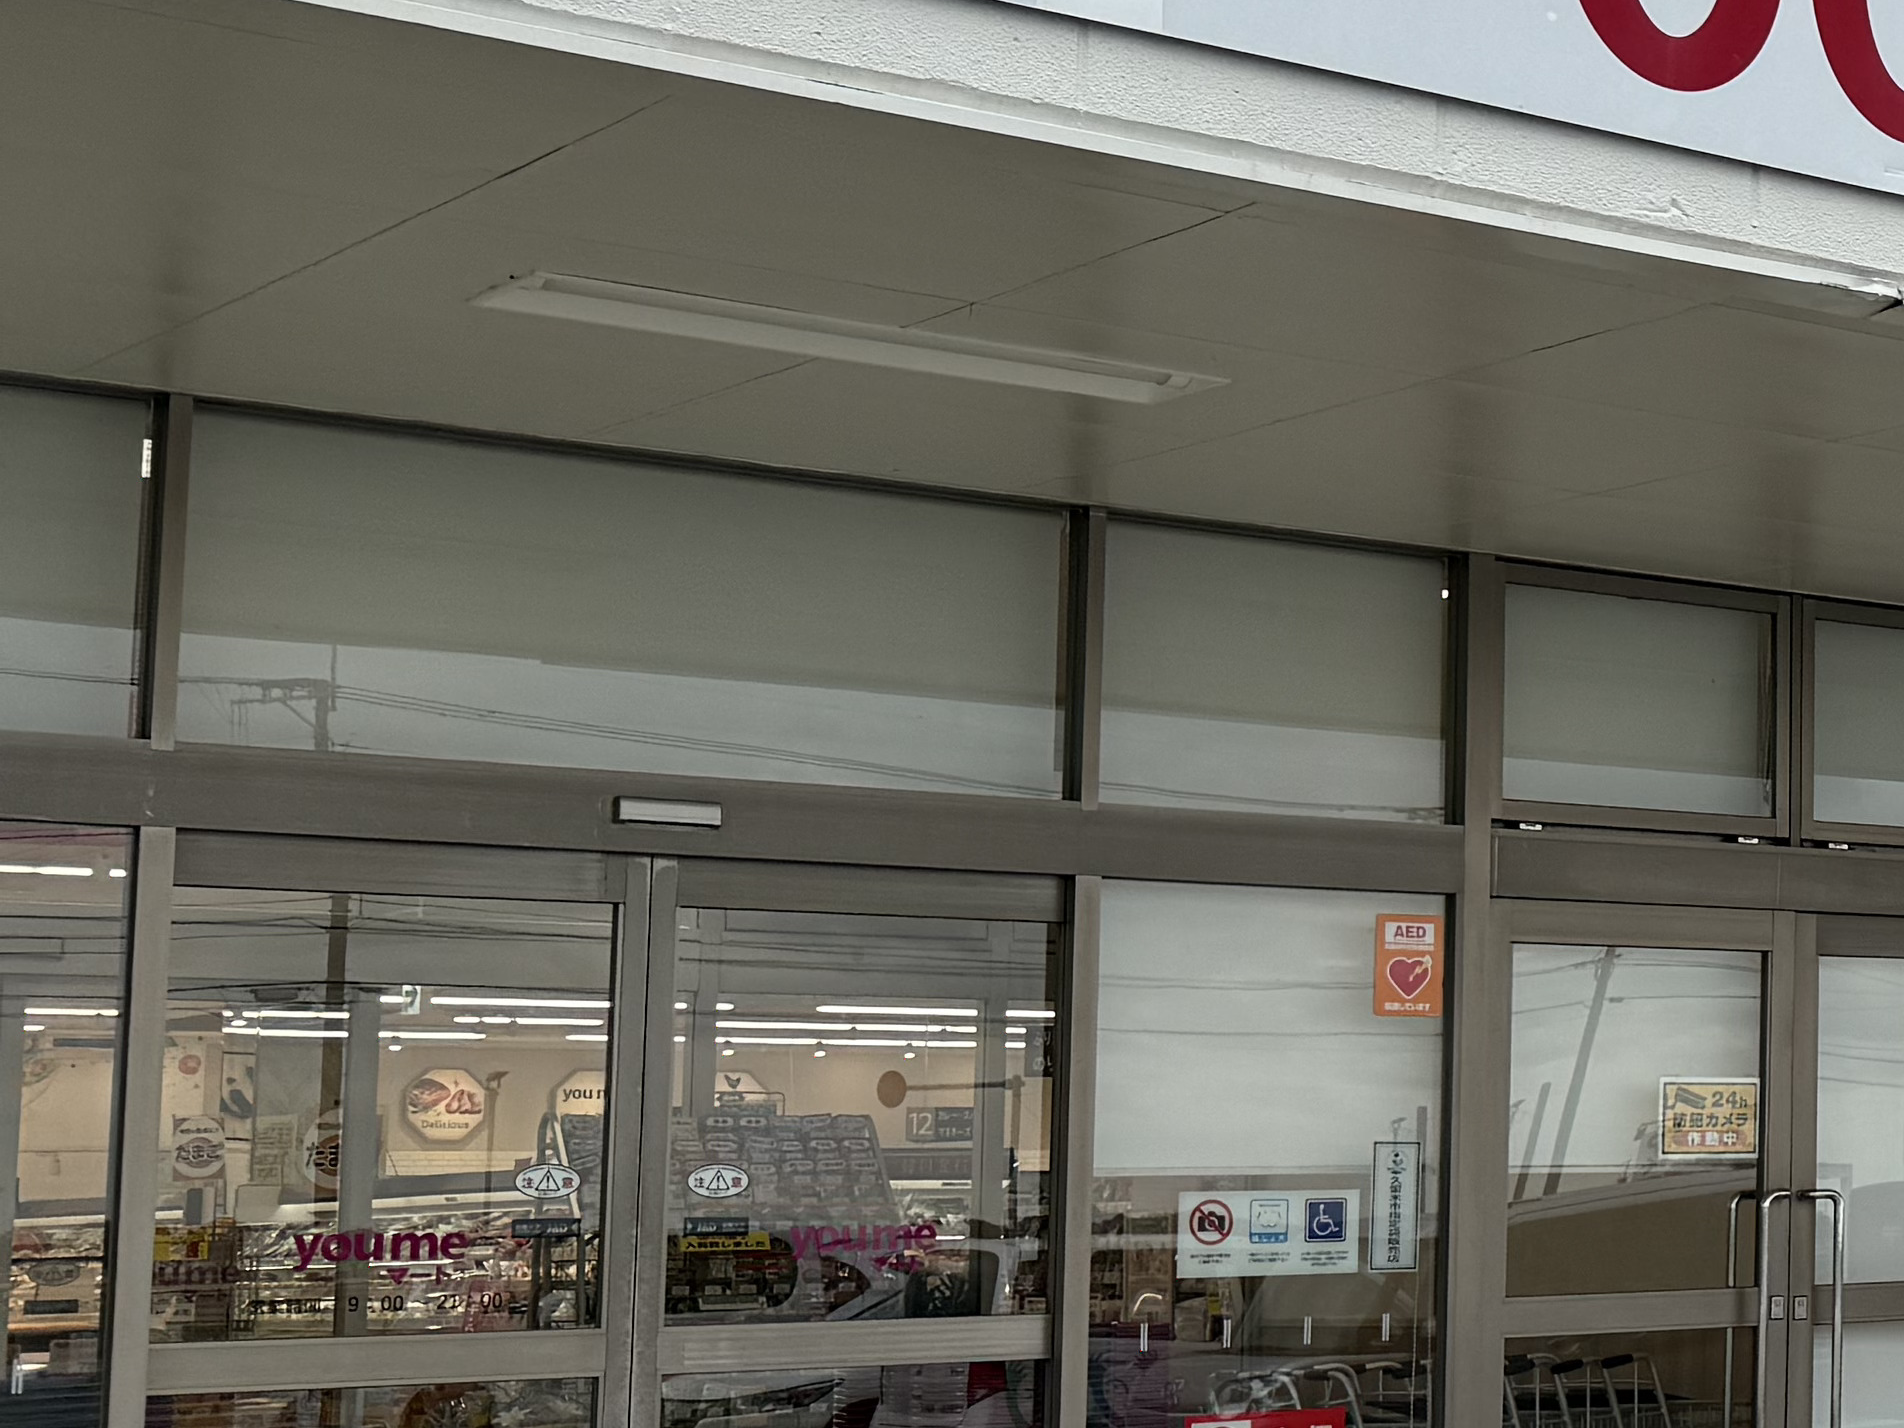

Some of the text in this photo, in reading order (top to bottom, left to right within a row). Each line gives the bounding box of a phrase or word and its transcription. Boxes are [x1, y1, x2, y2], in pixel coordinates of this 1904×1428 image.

[1394, 926, 1427, 938] AED
[1711, 1091, 1748, 1109] 24h
[909, 1112, 934, 1135] 12
[293, 1230, 470, 1272] youme
